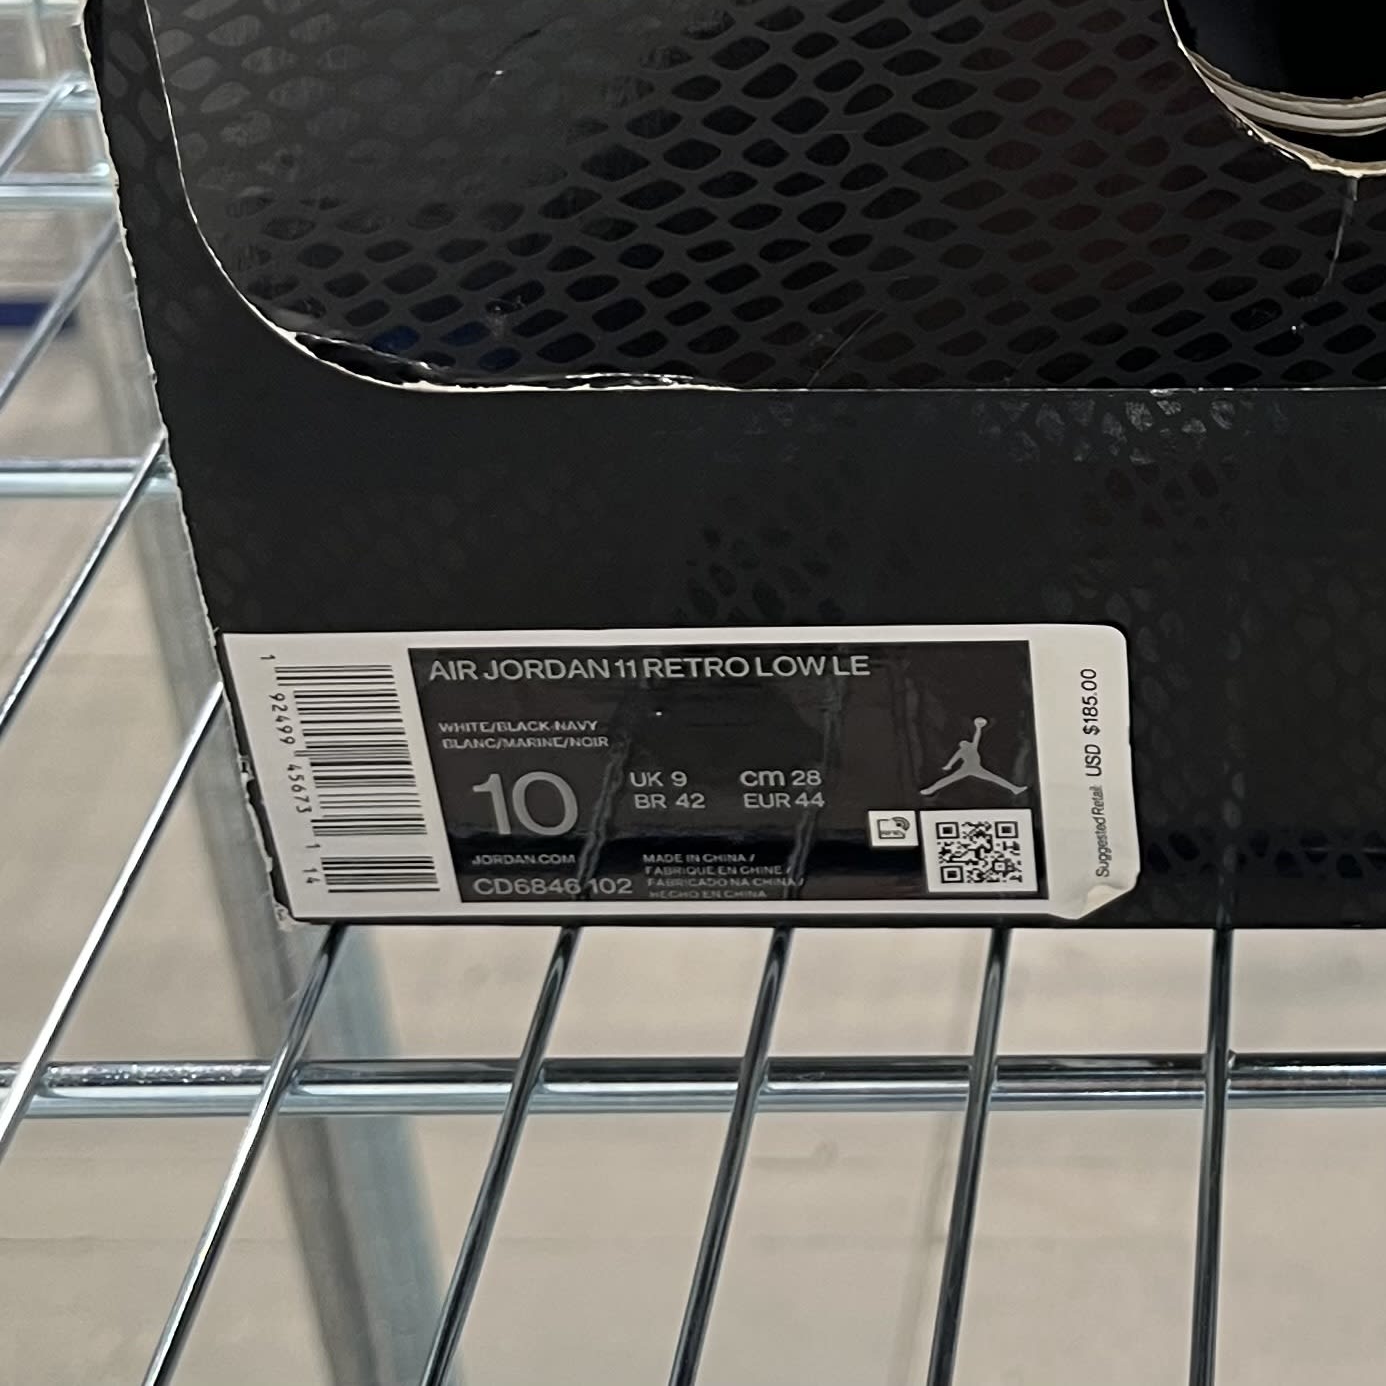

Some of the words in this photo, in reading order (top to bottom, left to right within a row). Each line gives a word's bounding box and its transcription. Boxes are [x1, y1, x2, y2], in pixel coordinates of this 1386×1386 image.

[429, 660, 479, 681] AIR
[483, 658, 611, 681] JORDAN
[614, 658, 638, 679] 11
[642, 657, 750, 679] RETRO
[754, 655, 827, 677] LOW
[832, 655, 871, 676] LE
[1079, 668, 1101, 736] $185.00
[442, 736, 609, 749] BLANC/MARINE/NOIR
[268, 692, 297, 745] 92499
[286, 763, 313, 813] 45673
[1084, 743, 1103, 777] USD
[629, 771, 664, 787] UK
[670, 770, 688, 787] 9
[791, 769, 823, 786] 28
[472, 771, 579, 836] 10
[633, 793, 667, 809] BR
[675, 792, 706, 809] 42
[743, 792, 791, 808] EUR
[794, 791, 825, 807] 44
[1088, 785, 1106, 816] Retail
[1092, 816, 1113, 878] Suggested
[471, 854, 576, 865] JORDAN.COM
[642, 853, 683, 863] MADE
[686, 853, 700, 863] IN
[702, 853, 746, 863] CHINA
[645, 866, 716, 876] FABRIQUE
[717, 866, 737, 875] EN
[739, 866, 783, 875] CHINE
